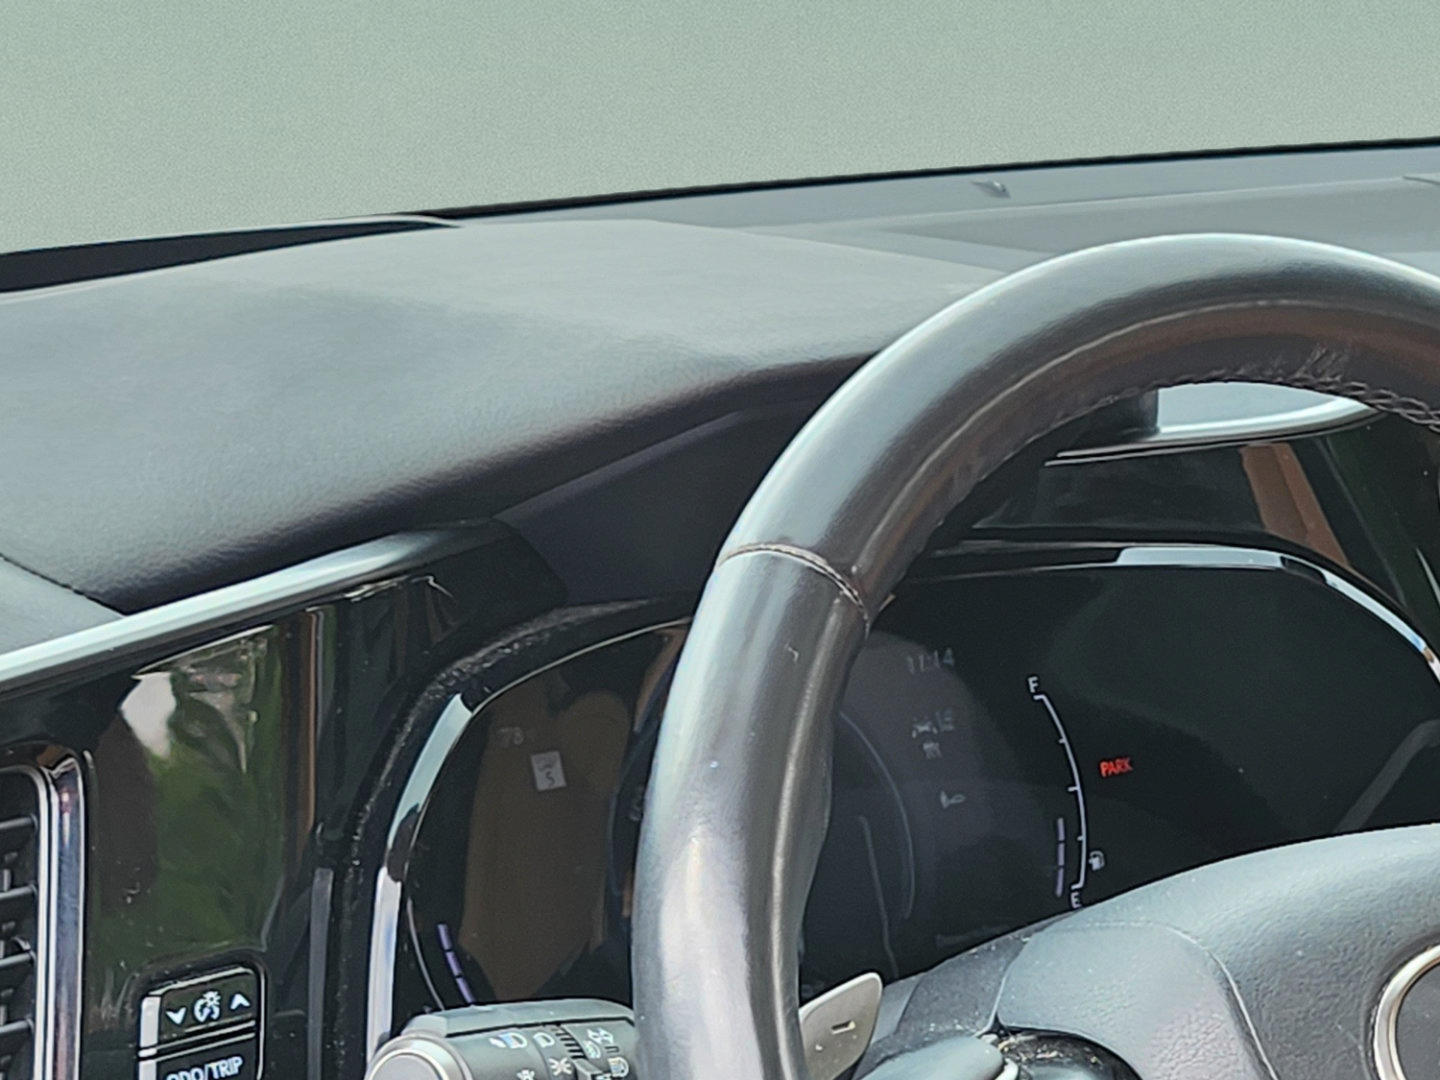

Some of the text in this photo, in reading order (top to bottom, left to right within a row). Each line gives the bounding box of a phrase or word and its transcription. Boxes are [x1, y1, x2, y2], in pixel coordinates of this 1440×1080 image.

[1028, 676, 1039, 693] F
[1099, 756, 1133, 778] PARK
[1070, 891, 1082, 908] E
